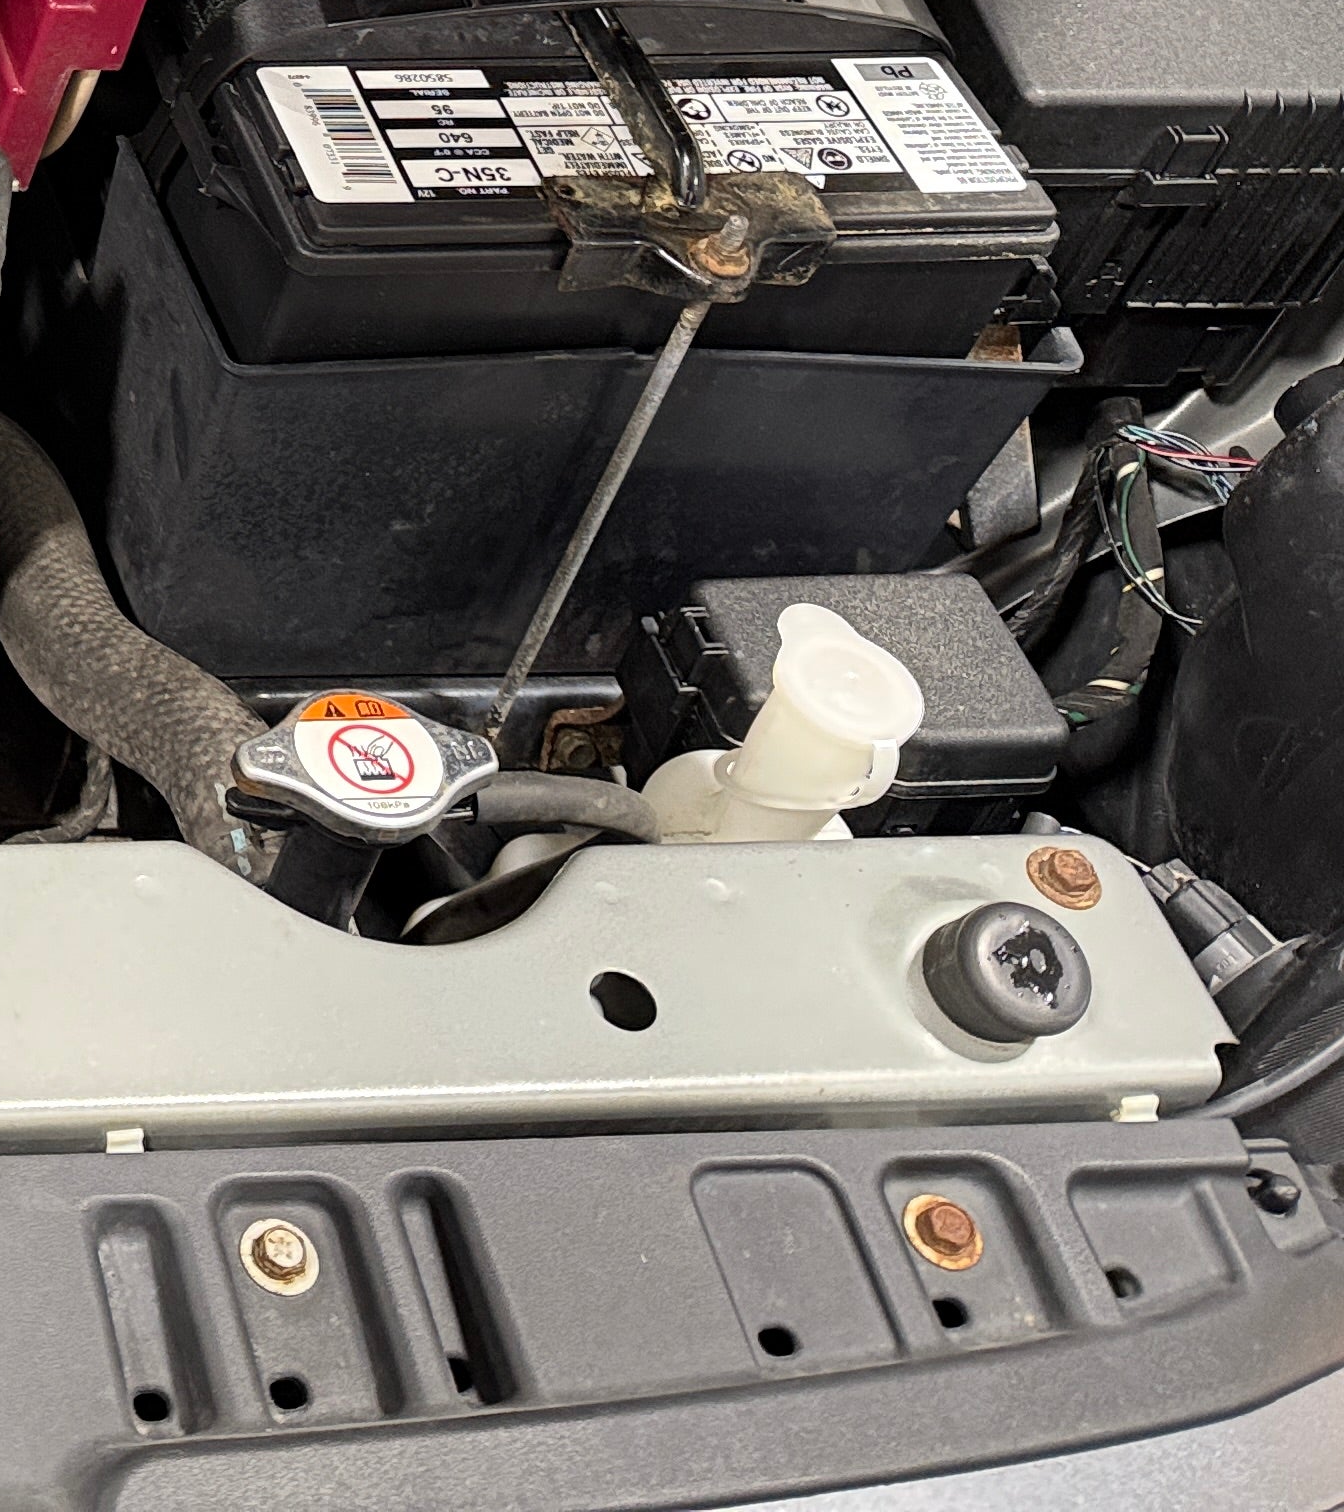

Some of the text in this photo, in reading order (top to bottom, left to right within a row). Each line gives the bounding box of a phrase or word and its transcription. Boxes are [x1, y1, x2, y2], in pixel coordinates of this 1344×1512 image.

[880, 66, 914, 78] Pb
[394, 74, 453, 83] 5850286
[431, 105, 454, 115] 95
[438, 133, 473, 143] 640
[793, 136, 876, 145] EXPLOSIVE GASES
[536, 146, 555, 154] GET
[564, 161, 628, 169] IMMEDIATELY
[435, 167, 512, 182] 35N-C
[417, 189, 436, 198] 12V
